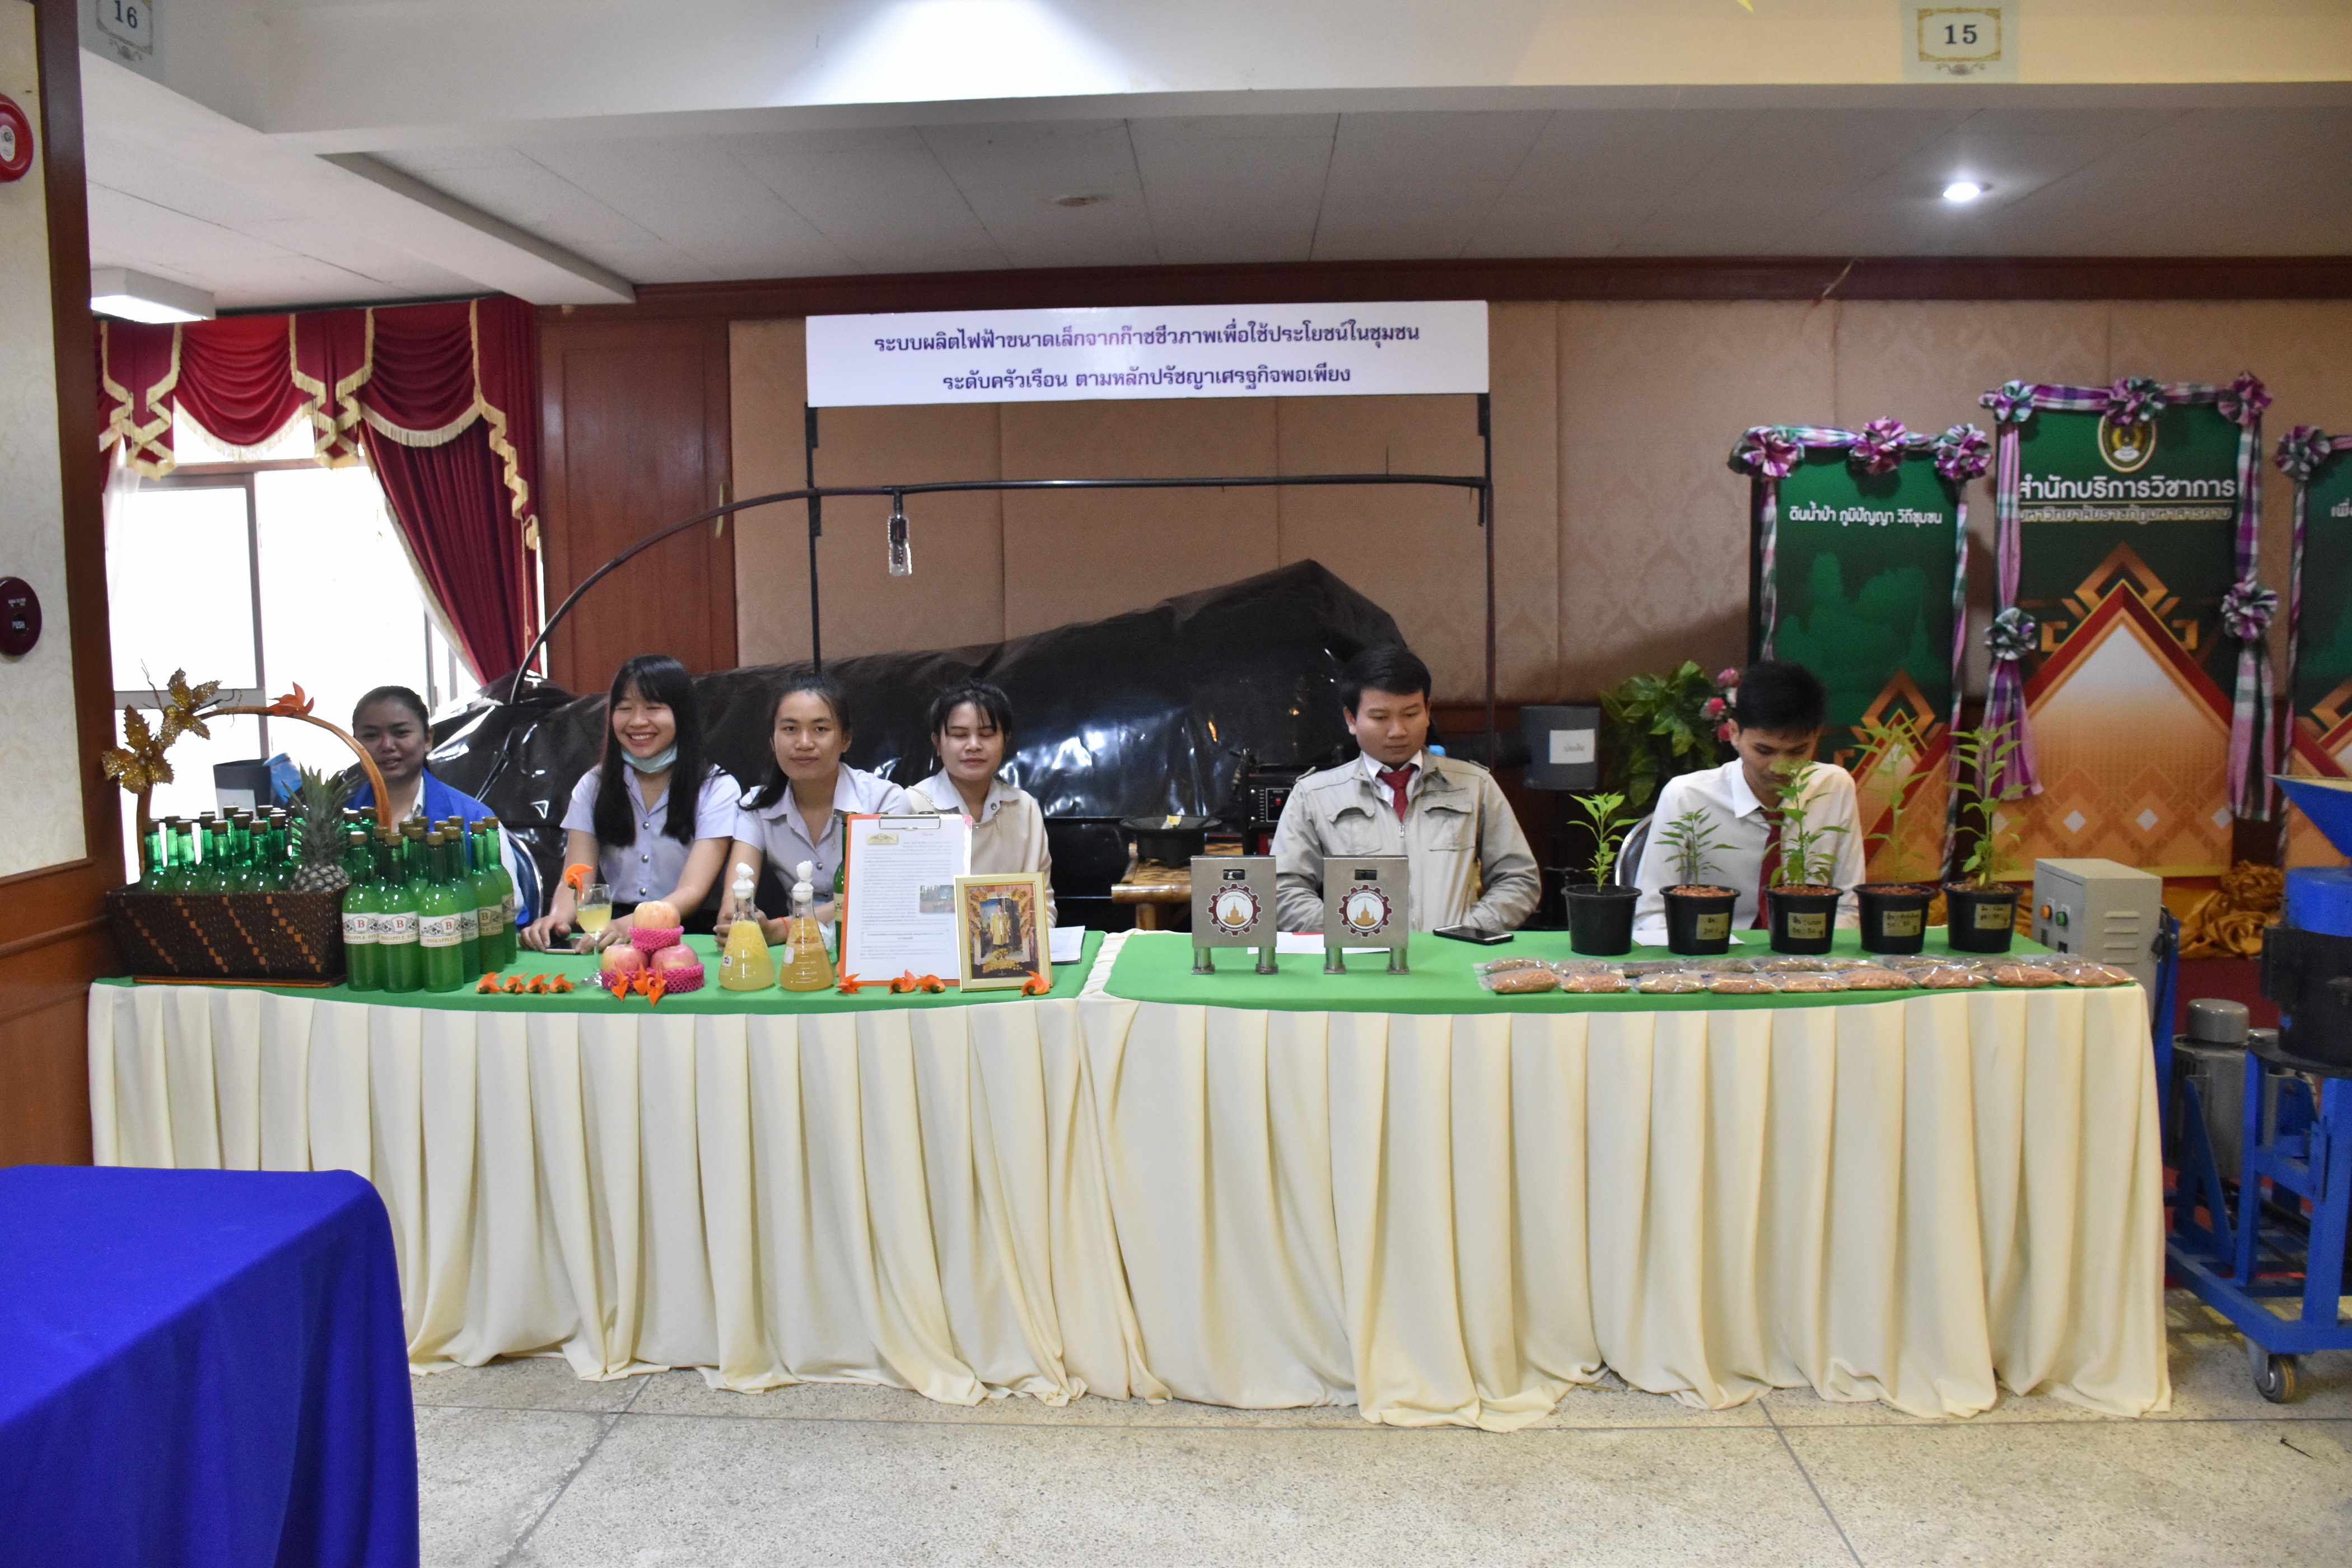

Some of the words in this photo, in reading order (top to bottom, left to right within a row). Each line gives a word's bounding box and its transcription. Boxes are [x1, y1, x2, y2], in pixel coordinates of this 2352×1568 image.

[114, 0, 138, 29] 16
[1945, 24, 1977, 44] 15
[944, 368, 1068, 390] ระดับครัวเรือน
[2019, 474, 2235, 499] สำนักบริการวิชาการ
[1839, 506, 1894, 526] ภูมิปัญญา
[1897, 508, 1943, 528] วิถีชุมชน
[481, 912, 488, 921] B
